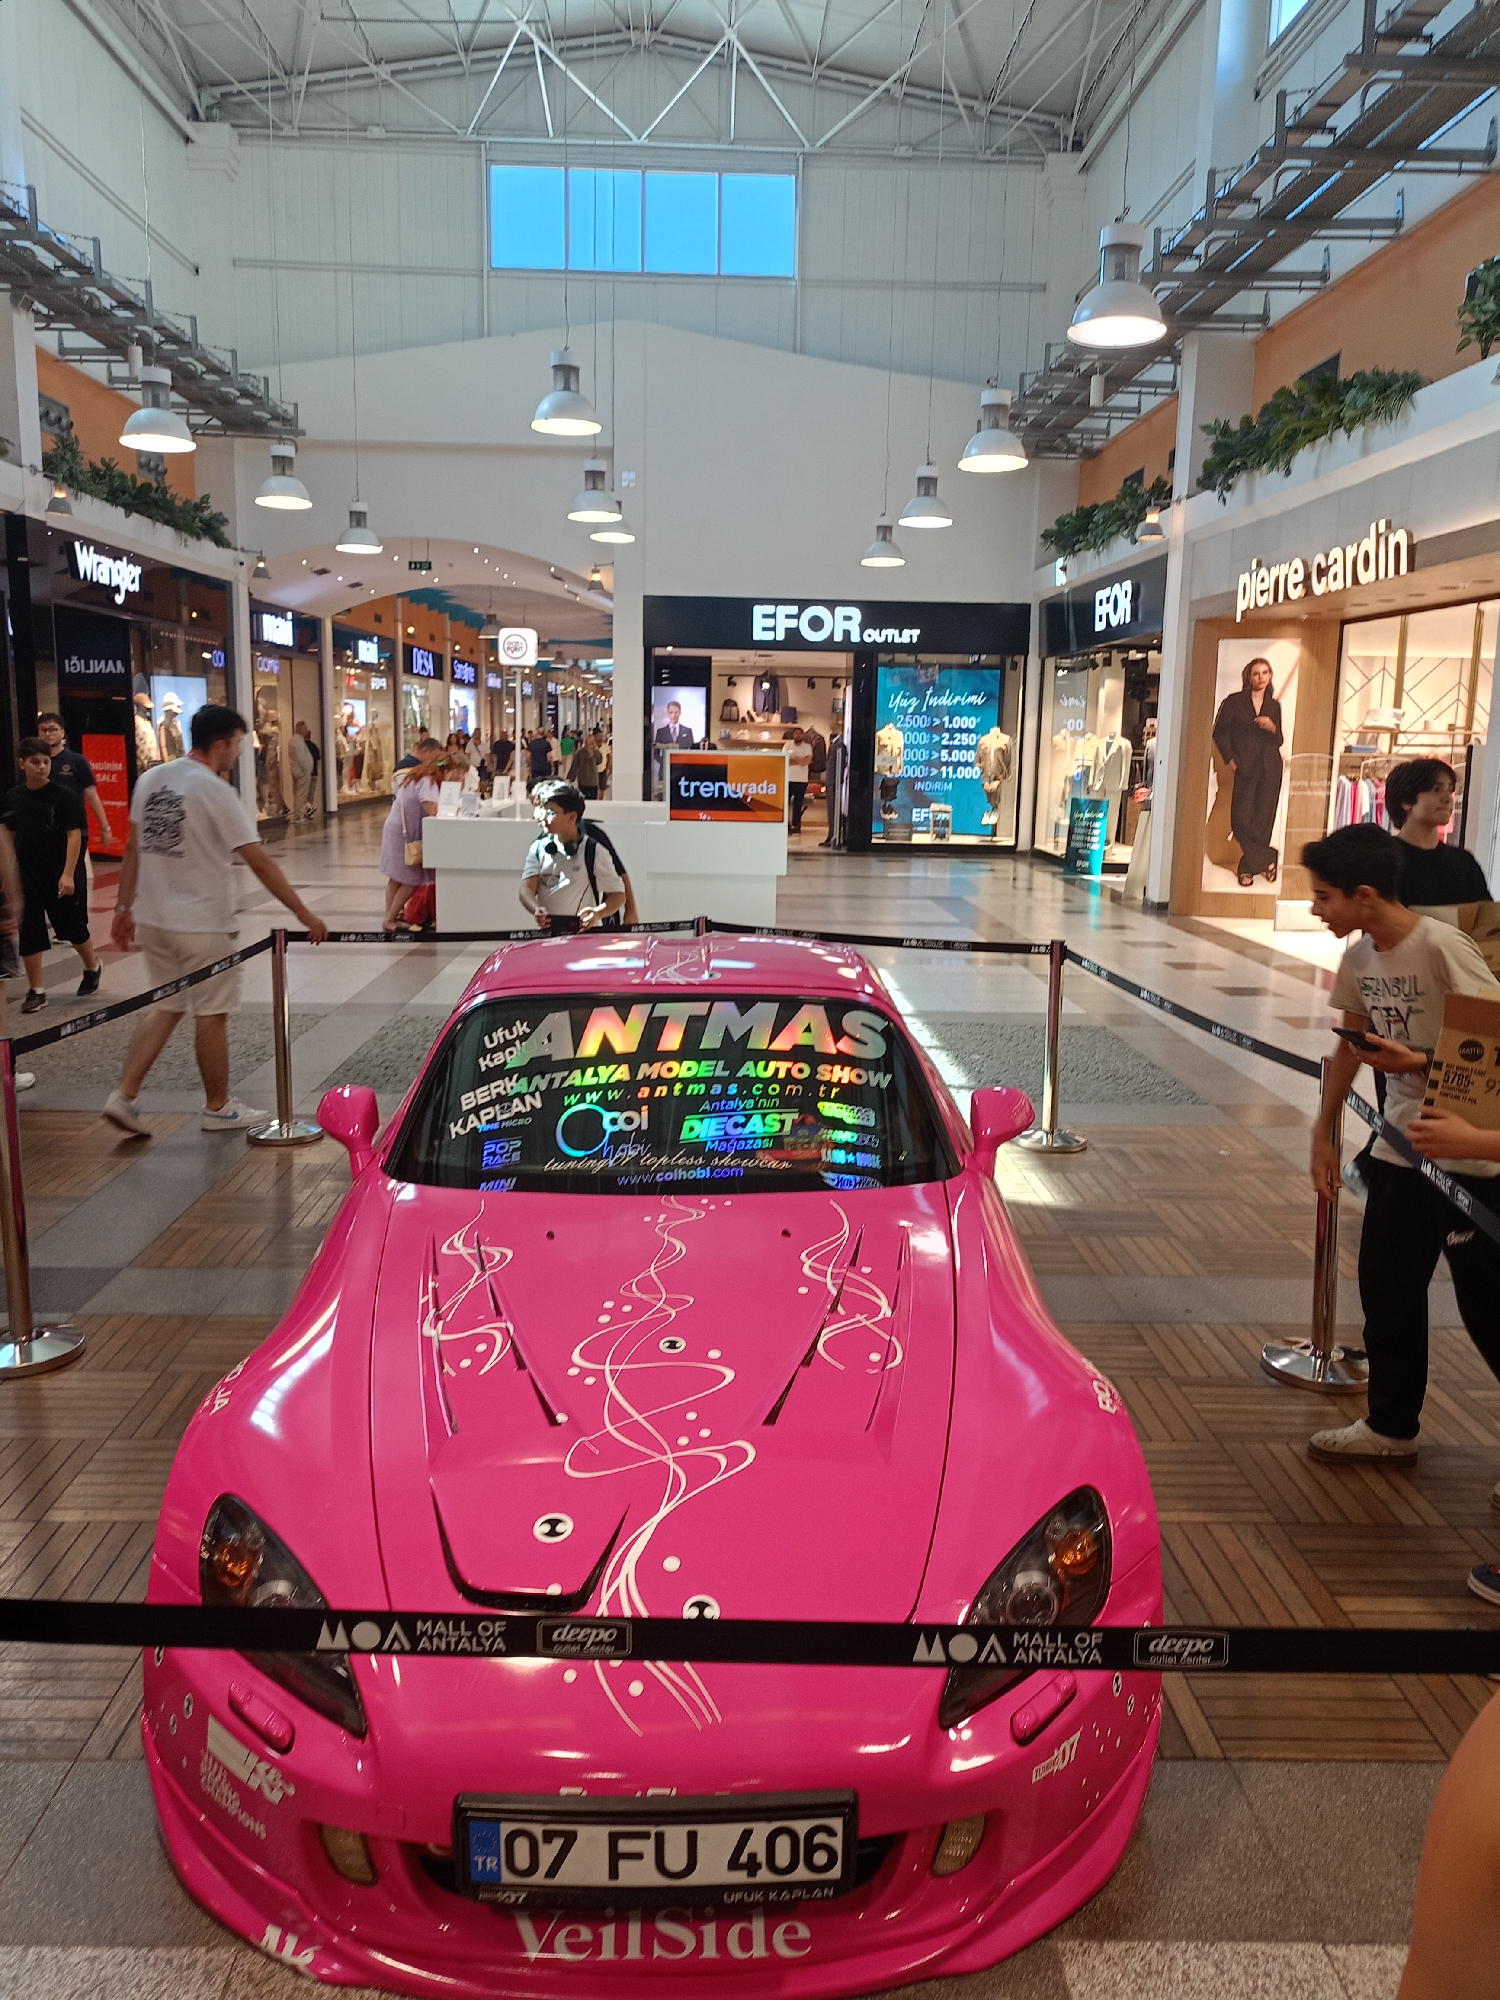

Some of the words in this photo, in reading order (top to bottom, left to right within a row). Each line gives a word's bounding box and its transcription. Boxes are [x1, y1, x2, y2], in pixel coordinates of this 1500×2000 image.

[74, 541, 142, 605] Wrangler
[1236, 557, 1304, 623] pierre
[1311, 518, 1408, 596] cardin
[1094, 579, 1132, 632] EFOR
[752, 604, 862, 643] EFOR
[863, 628, 921, 644] OUTLET
[412, 646, 435, 677] DESA
[96, 773, 118, 783] SALE
[484, 1019, 532, 1049] Ufuk
[504, 1002, 888, 1070] ANTMAS
[509, 1063, 632, 1097] ANTALYA
[636, 1060, 731, 1081] MODEL
[735, 1060, 812, 1080] AUTO
[815, 1064, 894, 1090] SHOW
[460, 1073, 520, 1112] BERK
[563, 1083, 841, 1107] www.antmas.com.tr
[449, 1091, 543, 1140] KAPLAN
[477, 1121, 500, 1134] TIME
[501, 1116, 533, 1129] MICRO
[682, 1112, 800, 1140] DIECAST
[482, 1150, 522, 1168] RACE
[483, 1140, 523, 1157] POP
[705, 1137, 774, 1154] Mağazası
[639, 1148, 707, 1172] topless
[416, 1620, 474, 1636] MALL
[477, 1620, 507, 1636] OF
[552, 1623, 618, 1650] deepo
[1013, 1632, 1069, 1648] MALL
[1074, 1632, 1104, 1648] OF
[416, 1636, 507, 1653] ANTALYA
[1013, 1647, 1103, 1664] ANTALYA
[1149, 1634, 1215, 1661] deepo
[473, 1855, 499, 1873] TR
[504, 1828, 579, 1880] 07
[607, 1829, 699, 1881] FU
[726, 1824, 840, 1878] 406
[724, 1890, 764, 1904] UFUK
[770, 1886, 834, 1902] KAPLAN
[511, 1906, 813, 1964] VeilSide
